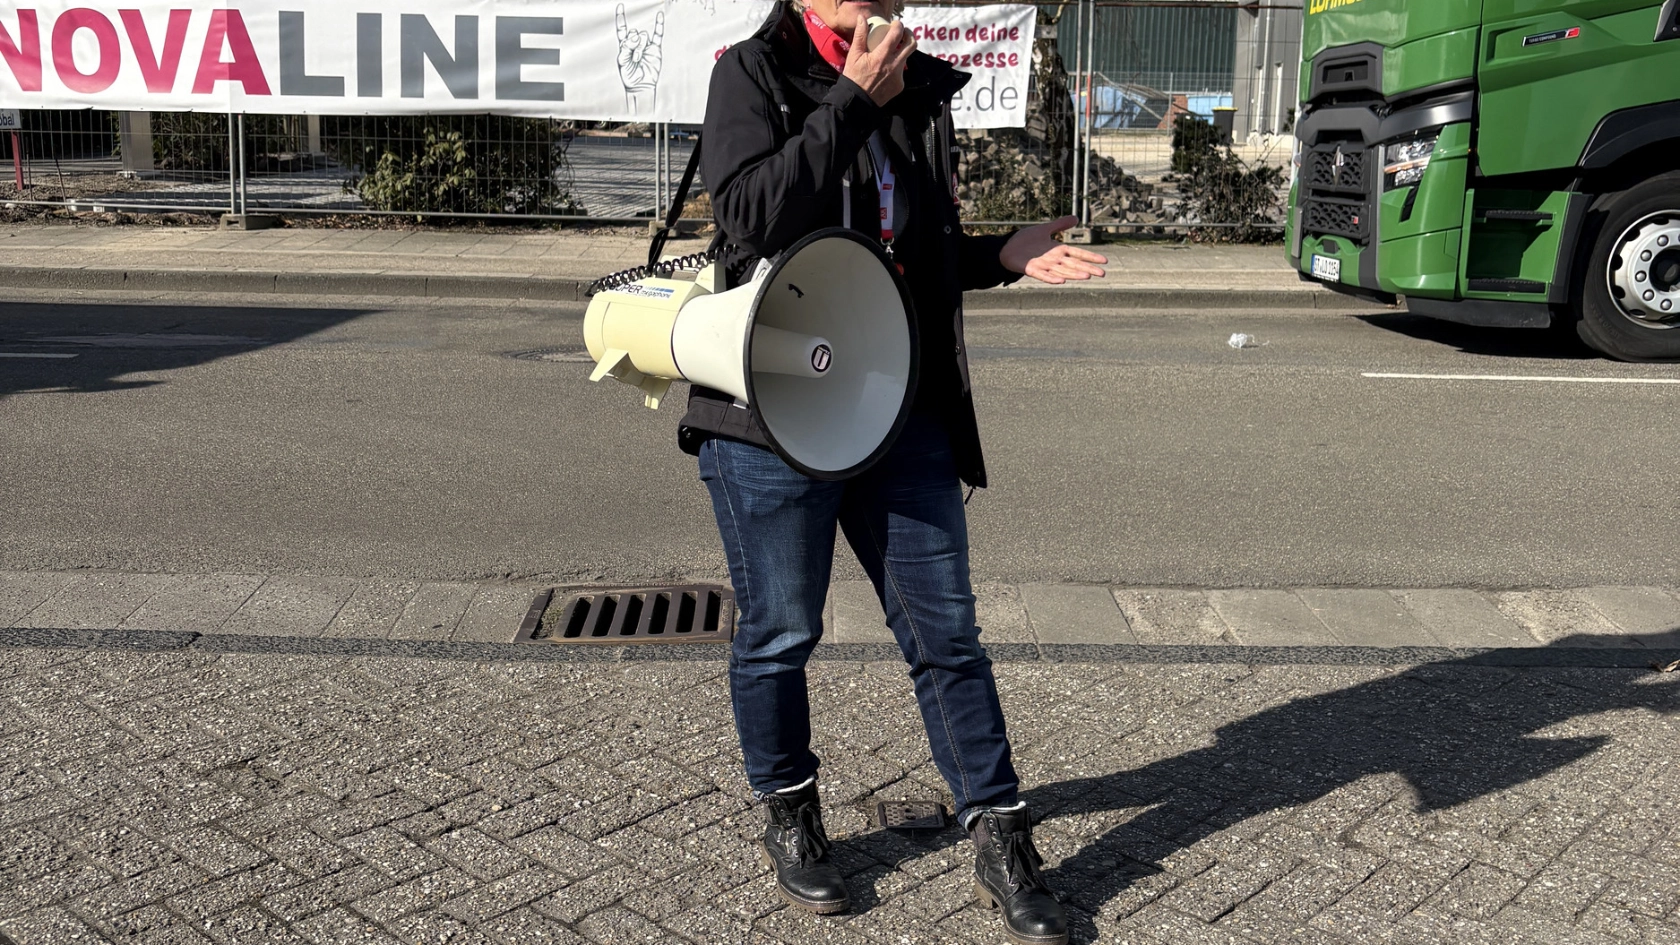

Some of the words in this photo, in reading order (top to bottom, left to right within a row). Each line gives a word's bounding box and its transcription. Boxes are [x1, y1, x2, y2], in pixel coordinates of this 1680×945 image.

[965, 22, 1020, 43] deine
[0, 8, 565, 102] NOVALINE
[928, 52, 1020, 68] ozesse
